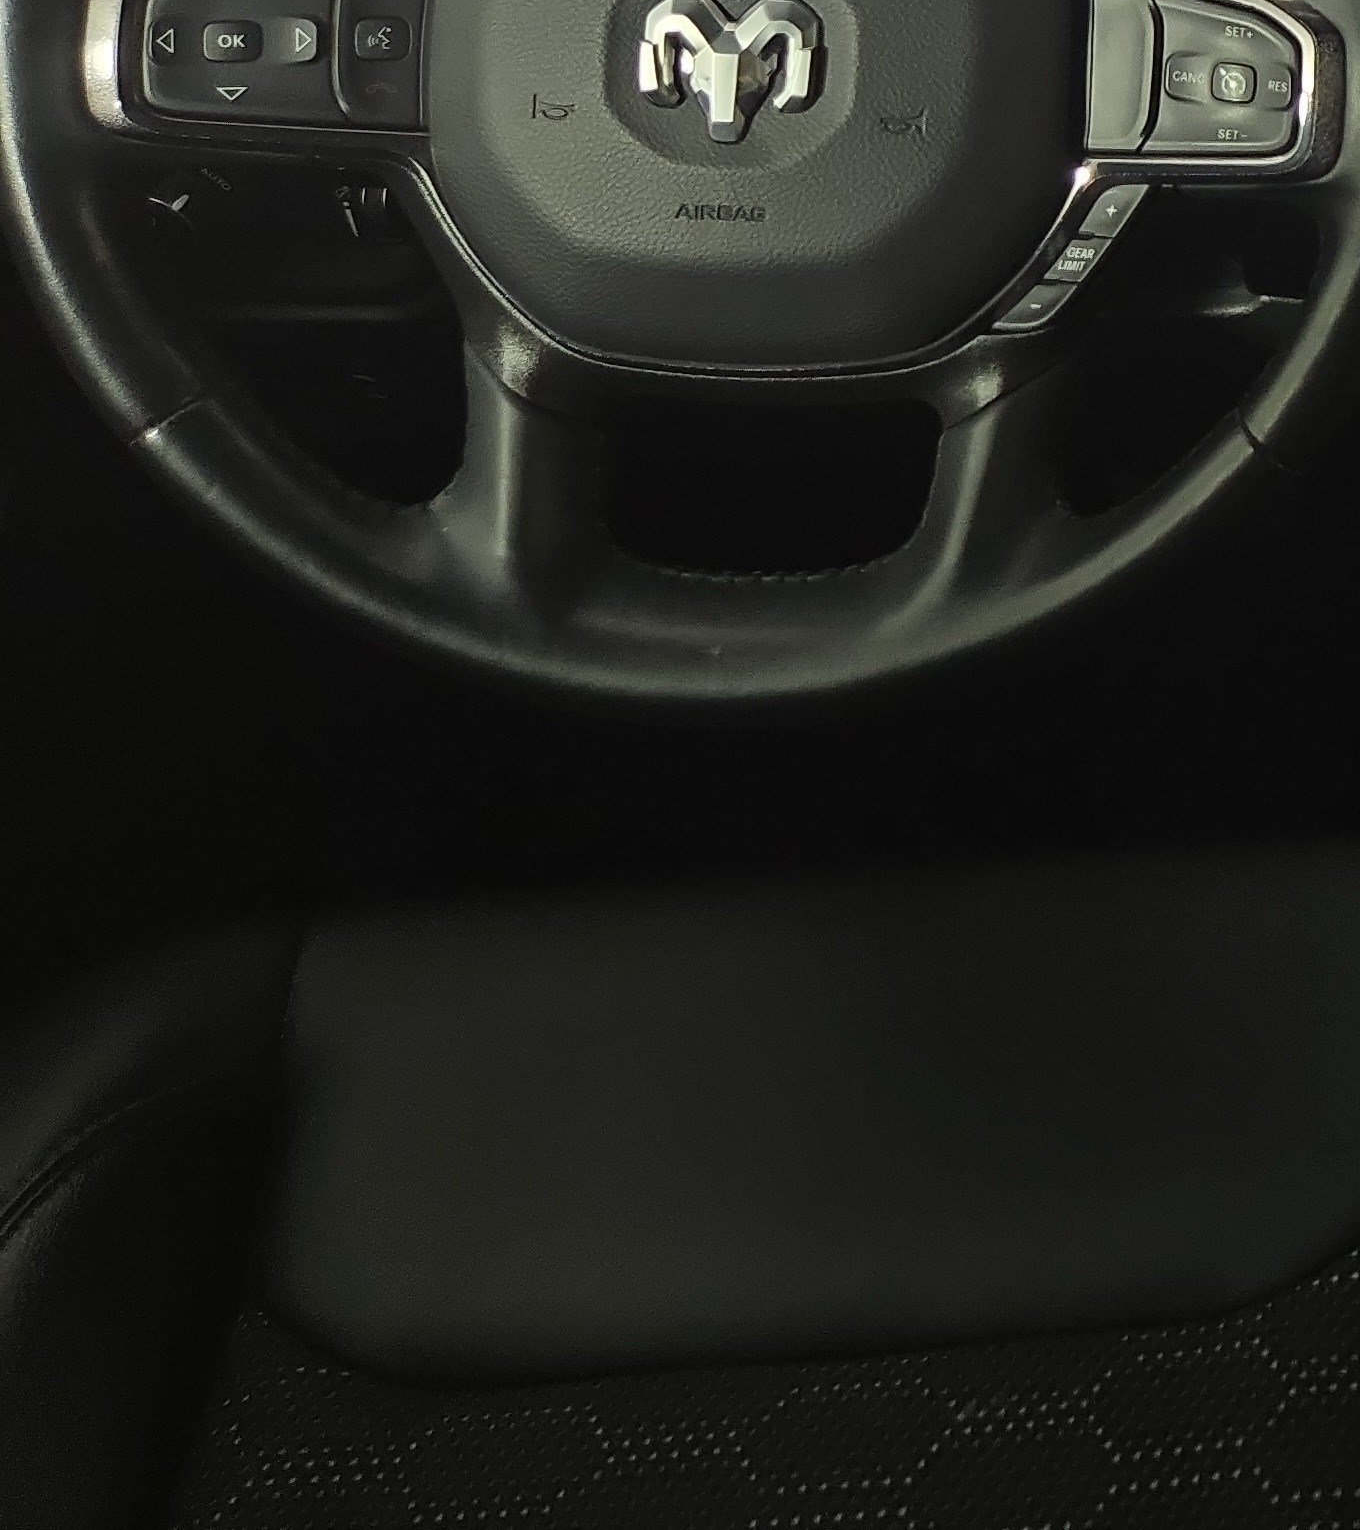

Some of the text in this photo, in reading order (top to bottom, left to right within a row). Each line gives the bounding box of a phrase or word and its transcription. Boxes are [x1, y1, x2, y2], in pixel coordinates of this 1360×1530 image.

[216, 33, 246, 50] OK
[1267, 80, 1288, 93] RES
[674, 202, 766, 222] AIRBAG
[1067, 246, 1095, 259] GEAR
[1057, 259, 1087, 272] LIMIT
